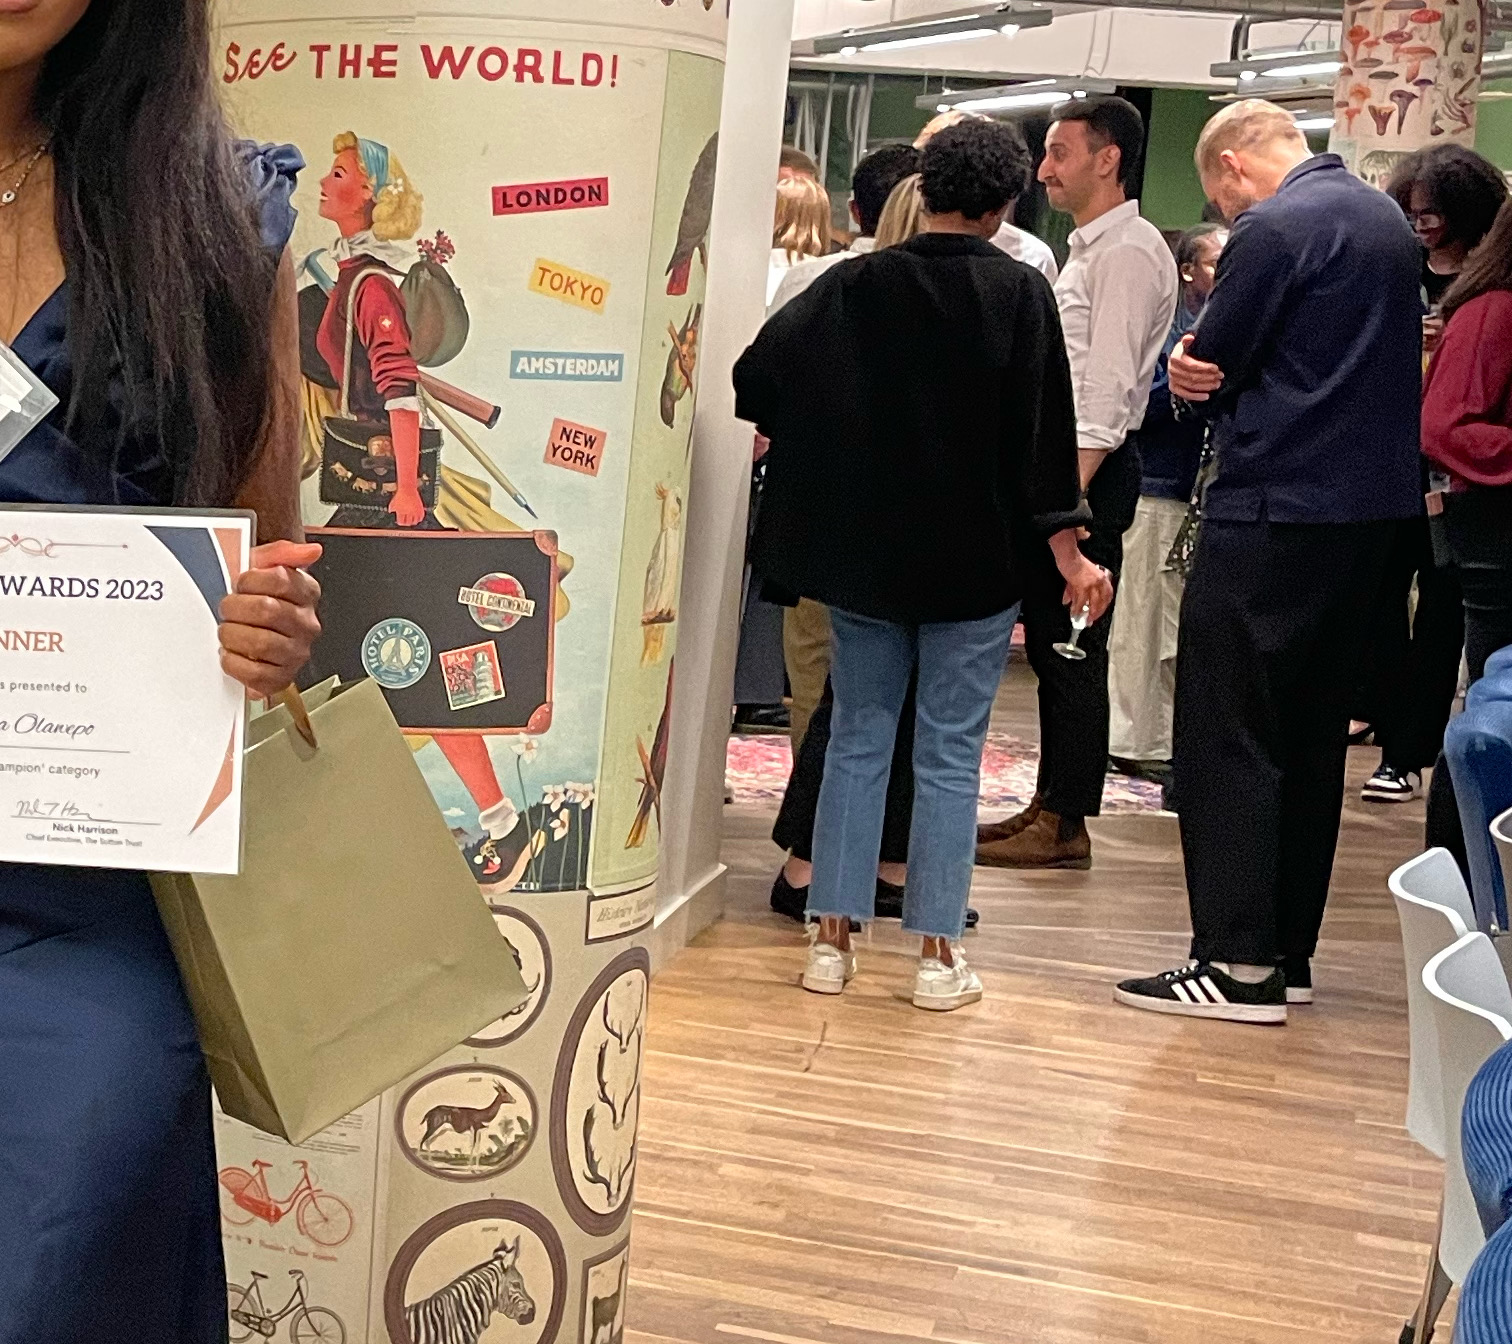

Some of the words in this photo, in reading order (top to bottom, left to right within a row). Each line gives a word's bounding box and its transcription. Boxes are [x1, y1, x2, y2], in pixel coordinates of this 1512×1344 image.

[309, 44, 399, 78] THE
[420, 44, 620, 88] WORLD!
[502, 184, 602, 210] LONDON
[538, 267, 603, 305] TOKYO
[516, 356, 619, 376] AMSTERDAM
[559, 427, 597, 449] NEW
[550, 445, 598, 469] YORK
[105, 579, 164, 601] 2023
[367, 626, 396, 669] HOTEL
[403, 627, 425, 674] PARIS
[10, 680, 70, 695] presented
[74, 682, 88, 694] to
[48, 764, 101, 779] category
[52, 823, 75, 832] Nick
[77, 824, 119, 835] Harrison
